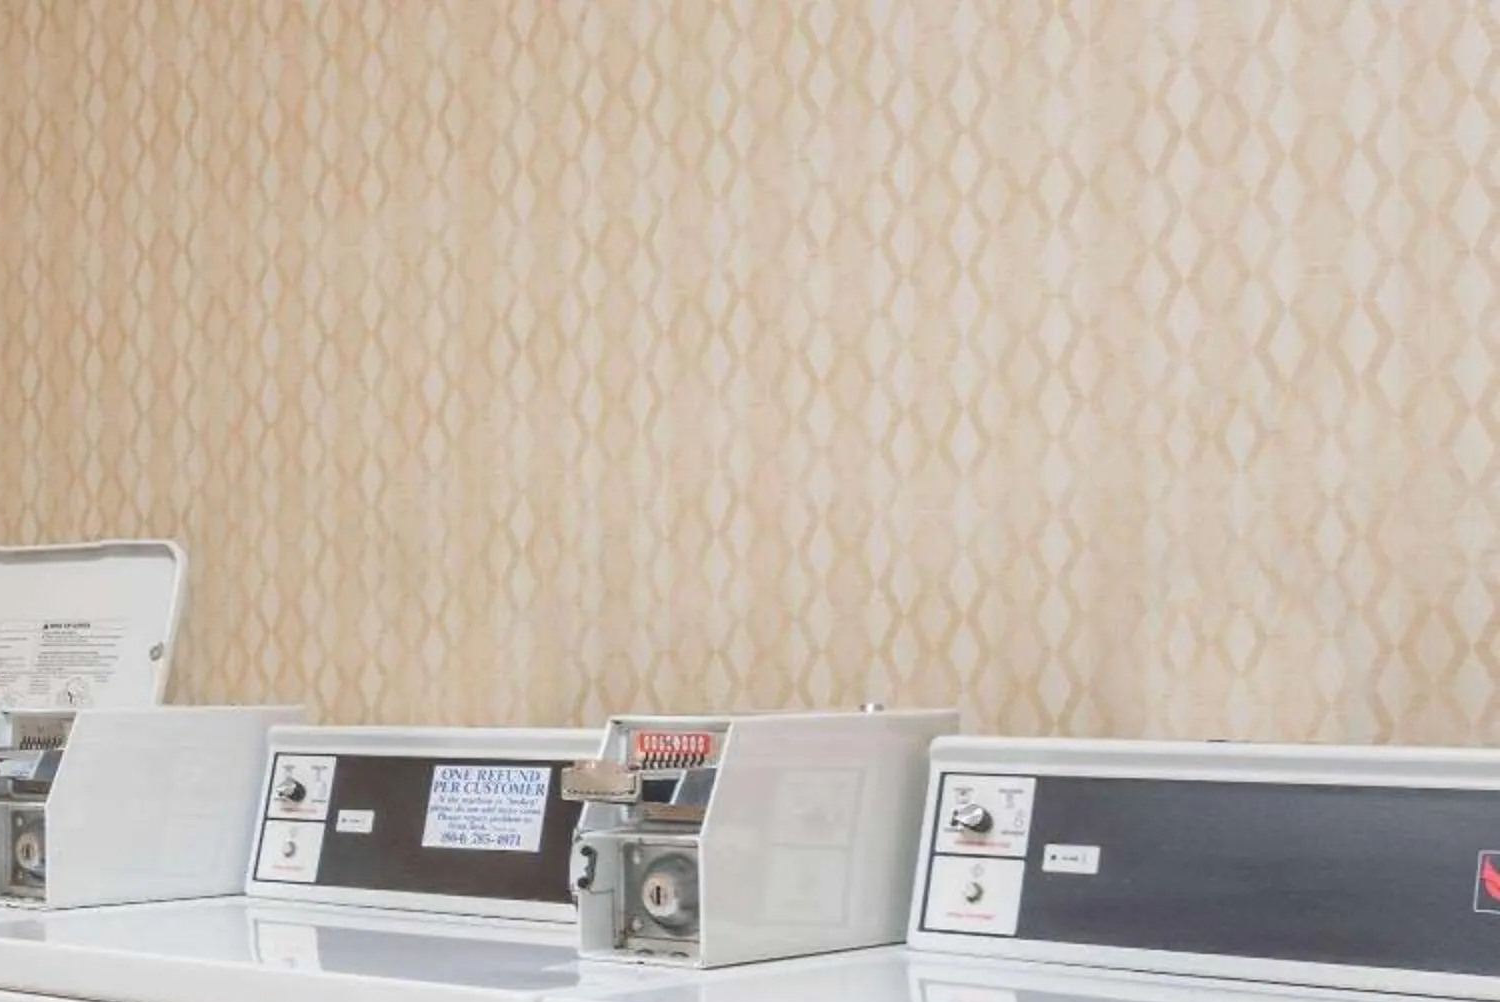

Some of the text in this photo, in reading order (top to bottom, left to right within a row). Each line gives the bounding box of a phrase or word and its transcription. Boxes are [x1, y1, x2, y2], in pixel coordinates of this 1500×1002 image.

[442, 768, 541, 782] ONE REFUND
[433, 780, 545, 796] PER CUSTOMER
